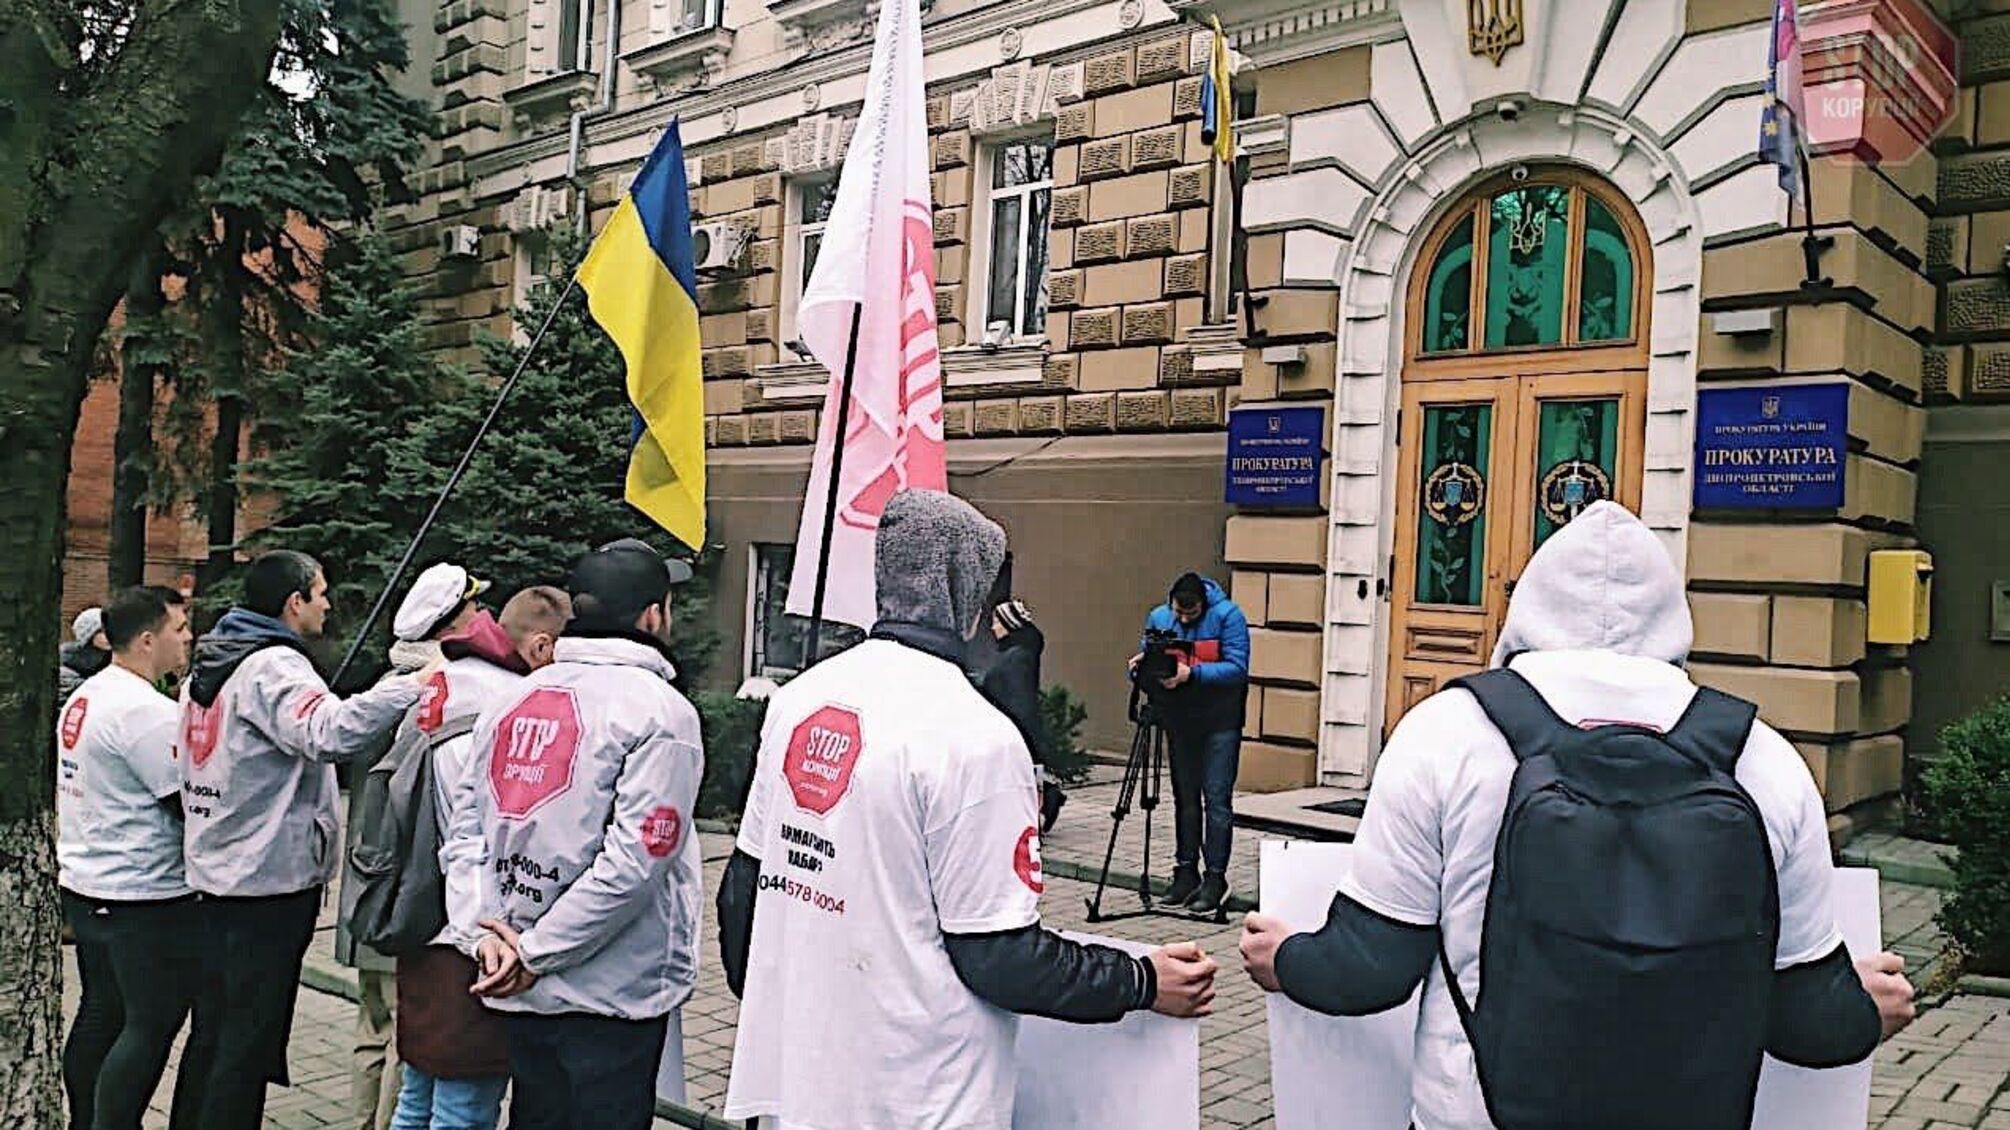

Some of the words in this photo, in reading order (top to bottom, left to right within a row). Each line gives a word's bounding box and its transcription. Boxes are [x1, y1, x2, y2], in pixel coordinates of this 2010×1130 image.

[1232, 457, 1314, 471] ПРОКУРАТУРА
[1705, 447, 1837, 466] ПРОКУРАТУРА
[806, 725, 852, 764] STOP
